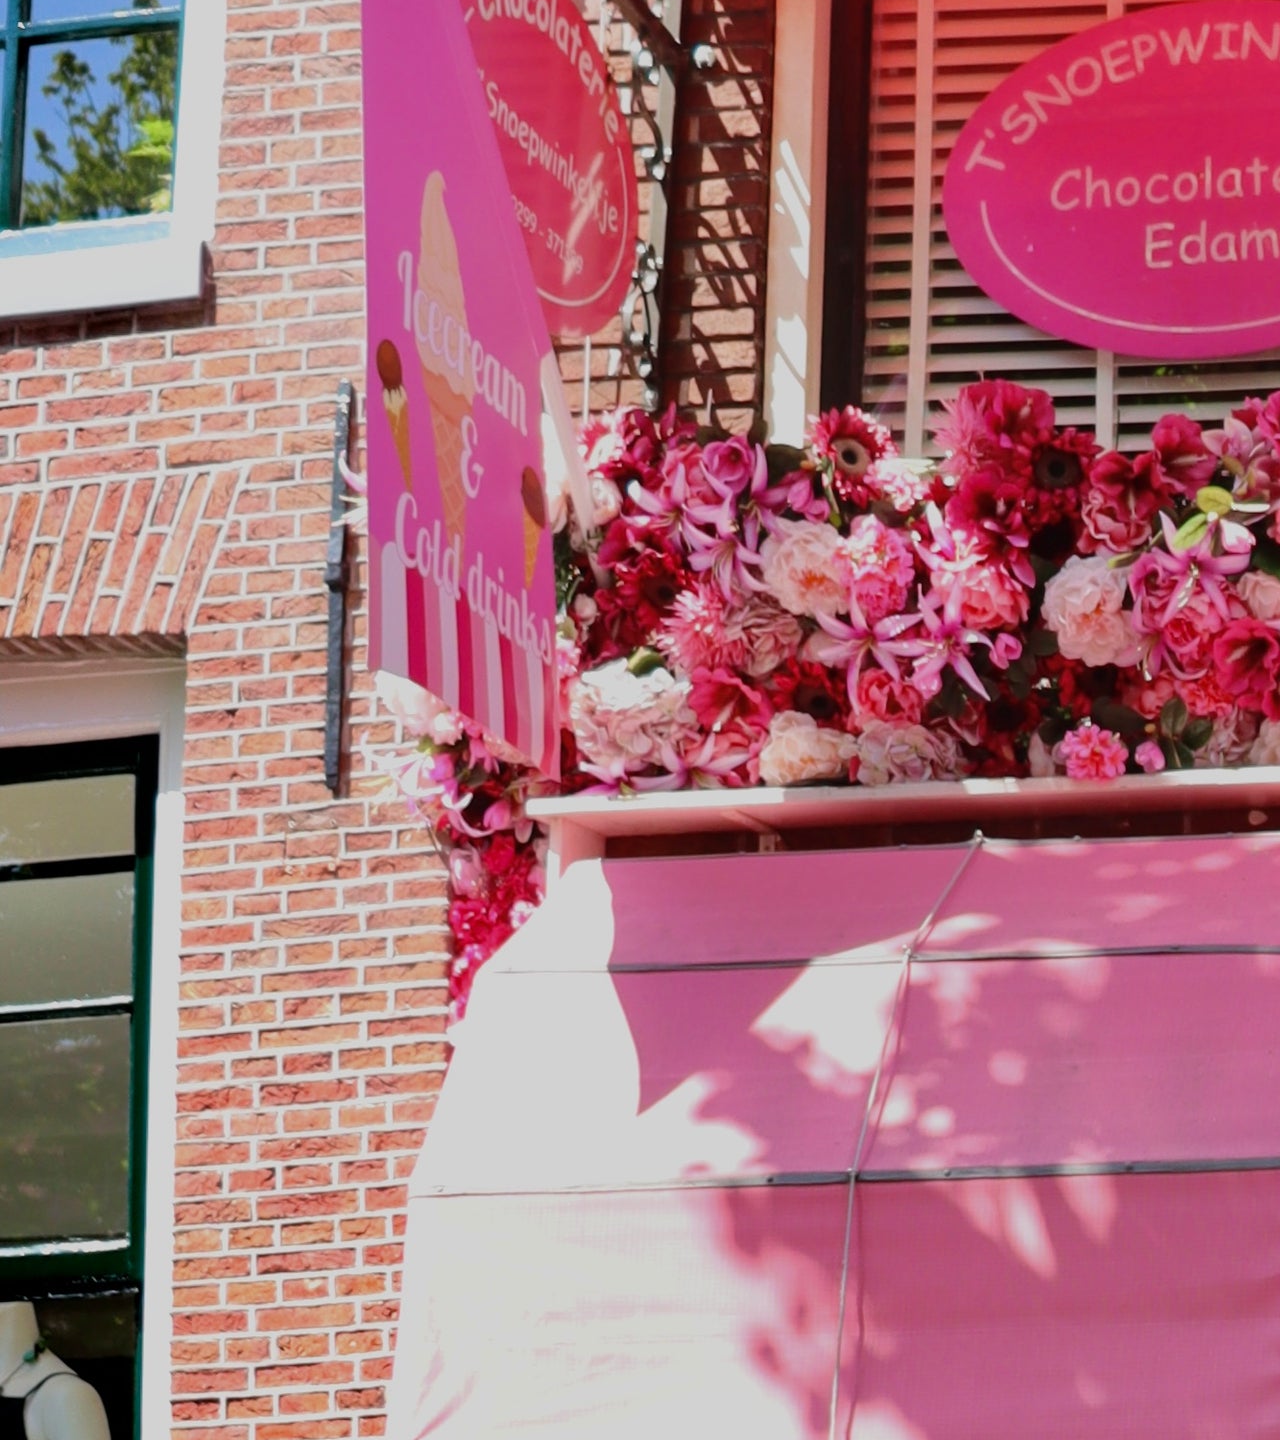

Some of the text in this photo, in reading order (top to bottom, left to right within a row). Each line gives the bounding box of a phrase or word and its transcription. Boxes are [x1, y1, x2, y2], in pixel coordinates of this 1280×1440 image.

[546, 227, 584, 275] 3719
[1143, 221, 1280, 270] Edam
[398, 250, 528, 437] Icecream
[459, 414, 485, 500] &
[395, 491, 553, 665] Cold drinks
